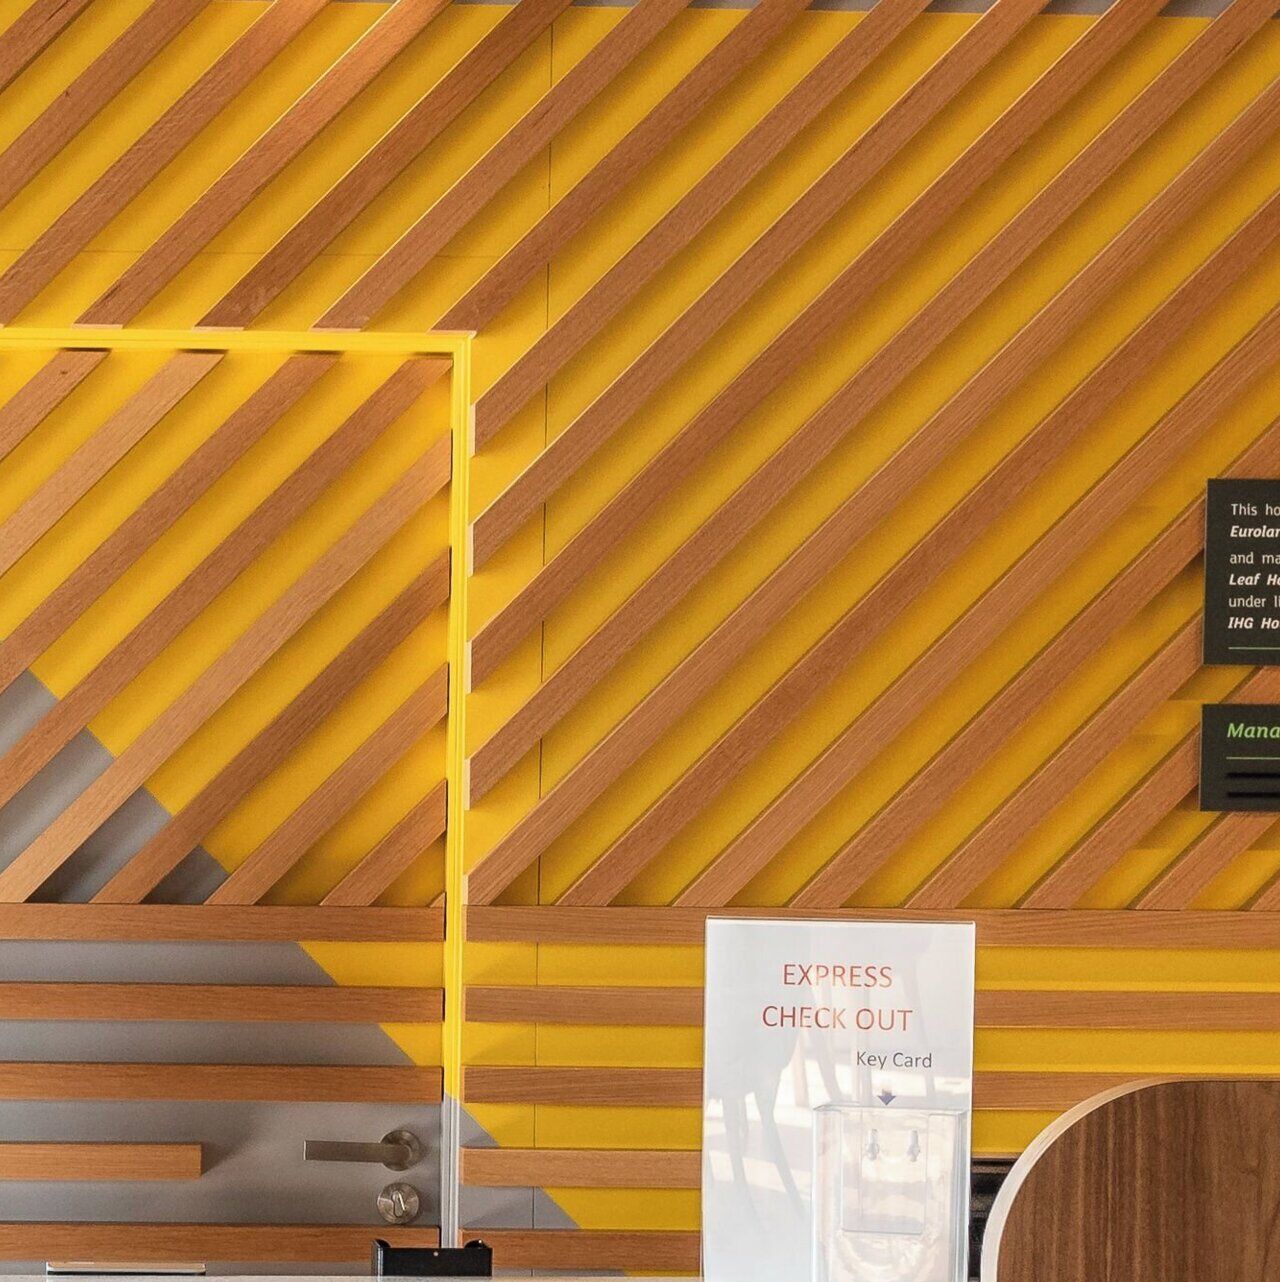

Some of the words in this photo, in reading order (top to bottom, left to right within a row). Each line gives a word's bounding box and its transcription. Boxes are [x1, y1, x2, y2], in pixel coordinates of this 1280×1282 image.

[1230, 502, 1258, 517] This
[1229, 551, 1254, 565] and
[1228, 572, 1262, 586] Leaf
[1228, 594, 1267, 608] under
[1227, 616, 1254, 630] IHG
[783, 963, 893, 988] EXPRESS
[762, 1005, 846, 1030] CHECK
[855, 1007, 913, 1031] OUT
[856, 1050, 888, 1070] Key
[892, 1051, 933, 1068] Card
